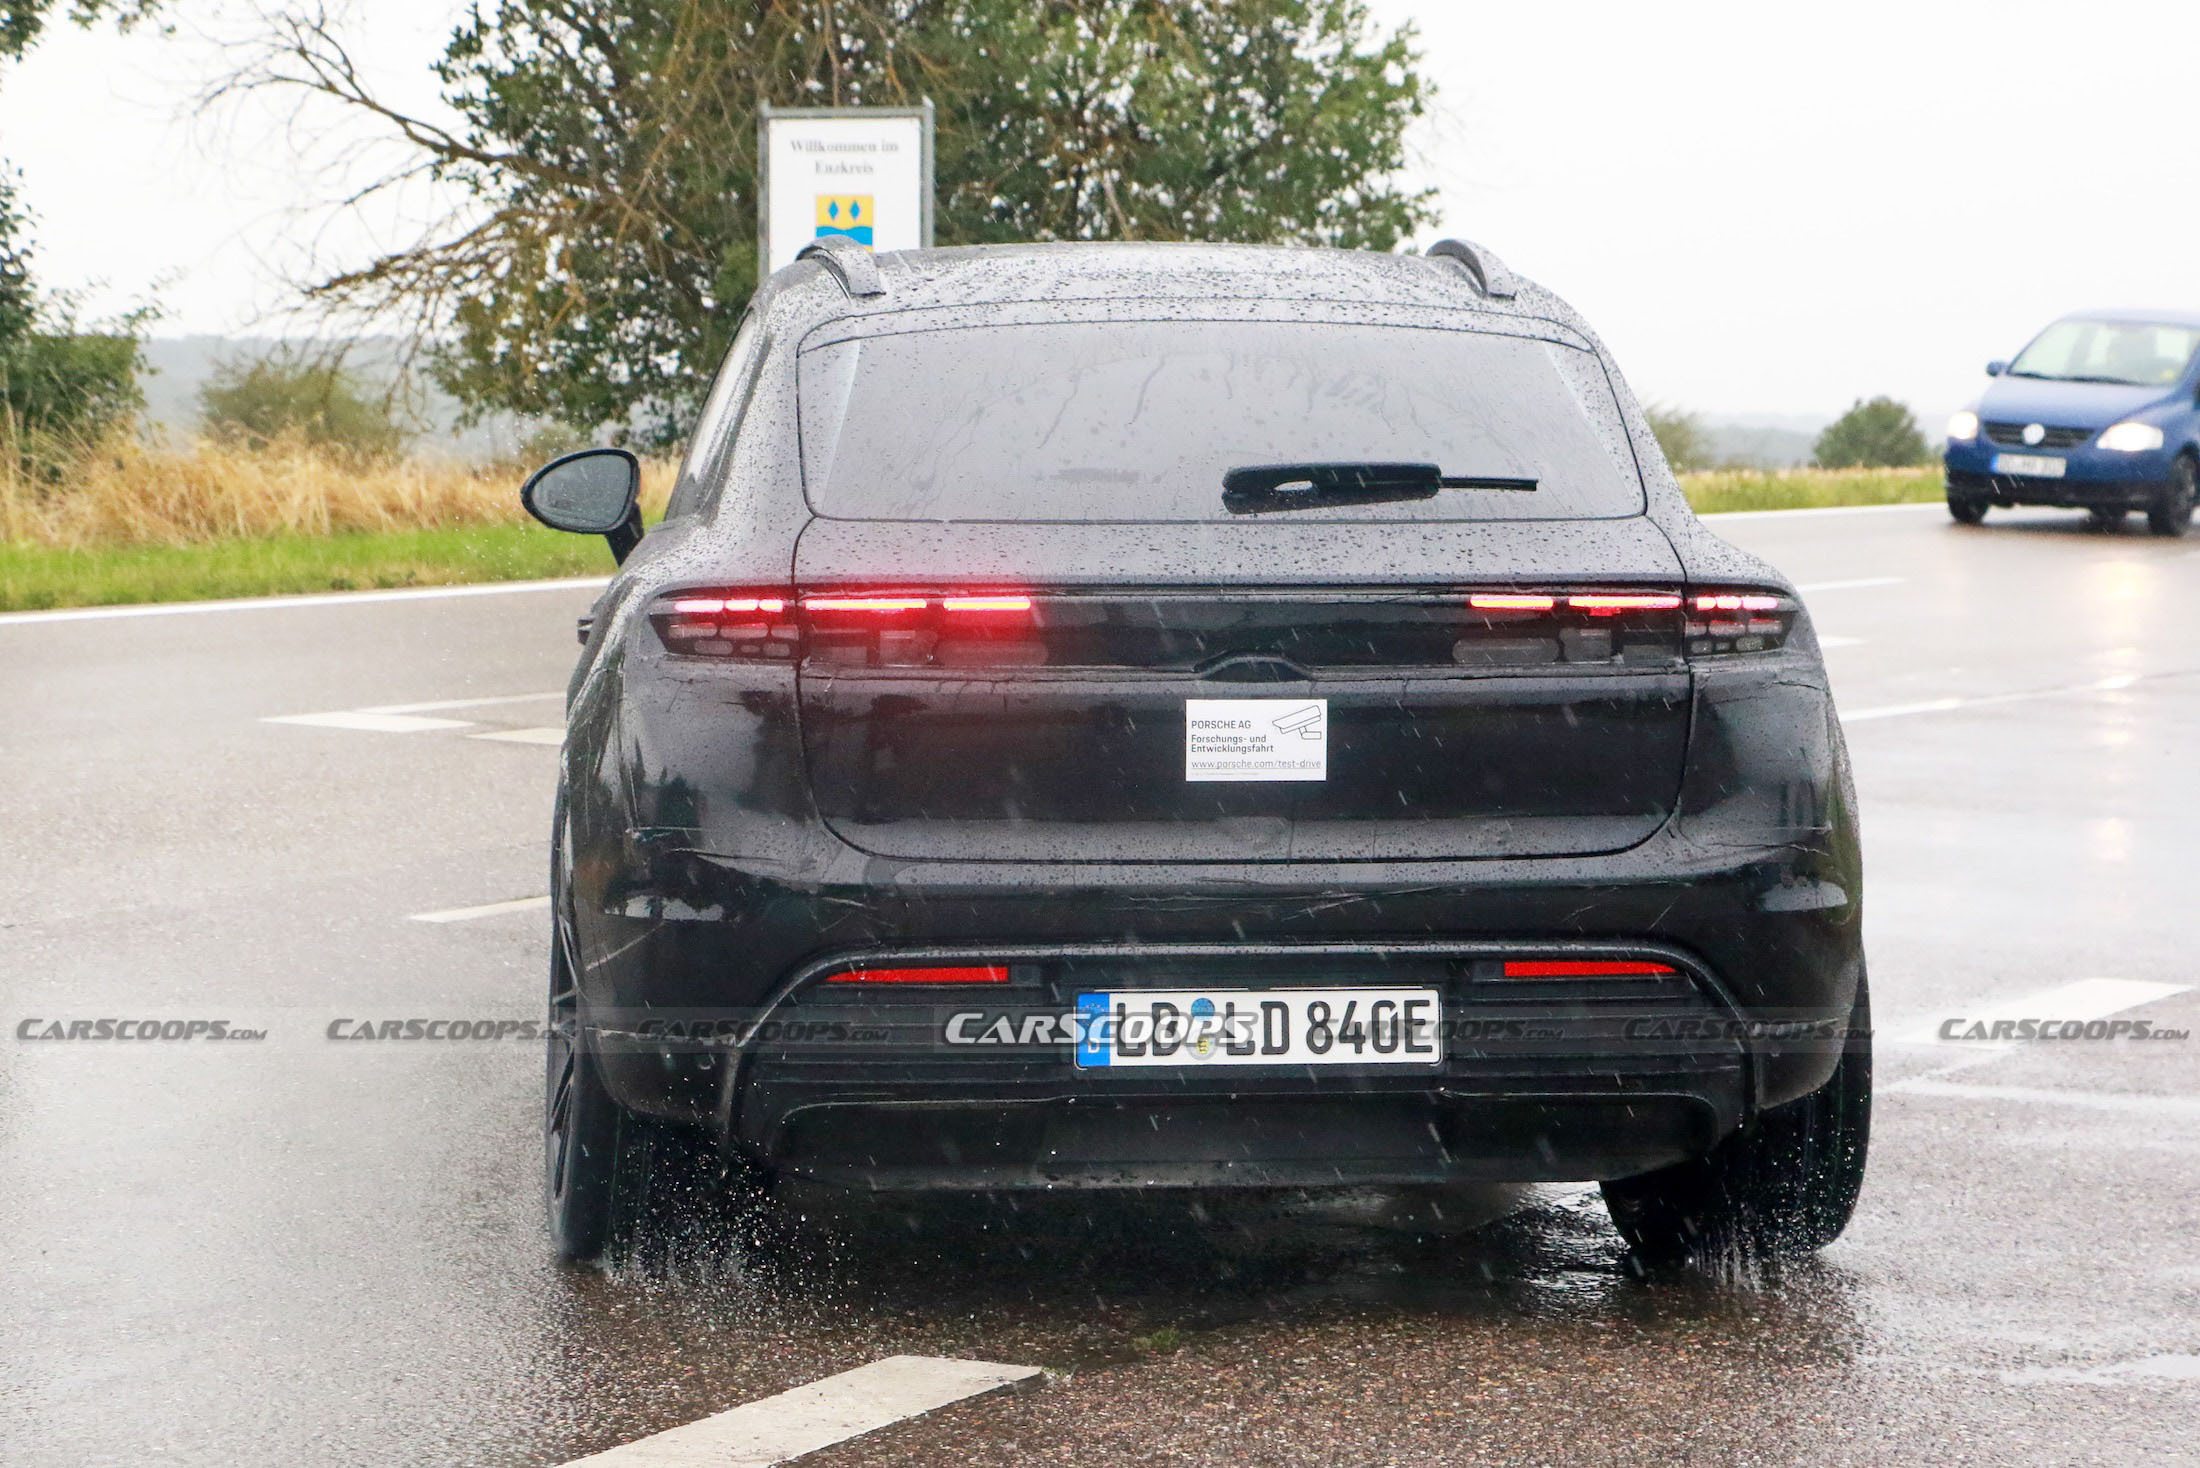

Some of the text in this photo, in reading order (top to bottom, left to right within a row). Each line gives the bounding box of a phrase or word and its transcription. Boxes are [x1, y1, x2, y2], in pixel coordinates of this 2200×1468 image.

[790, 138, 899, 153] Willkommen im
[1191, 720, 1251, 729] PORSCHE AG
[1191, 735, 1266, 745] Forschungs- und
[1191, 744, 1274, 754] Entwicklungsfahrt
[1191, 760, 1321, 769] www.porsche.com/test-drive
